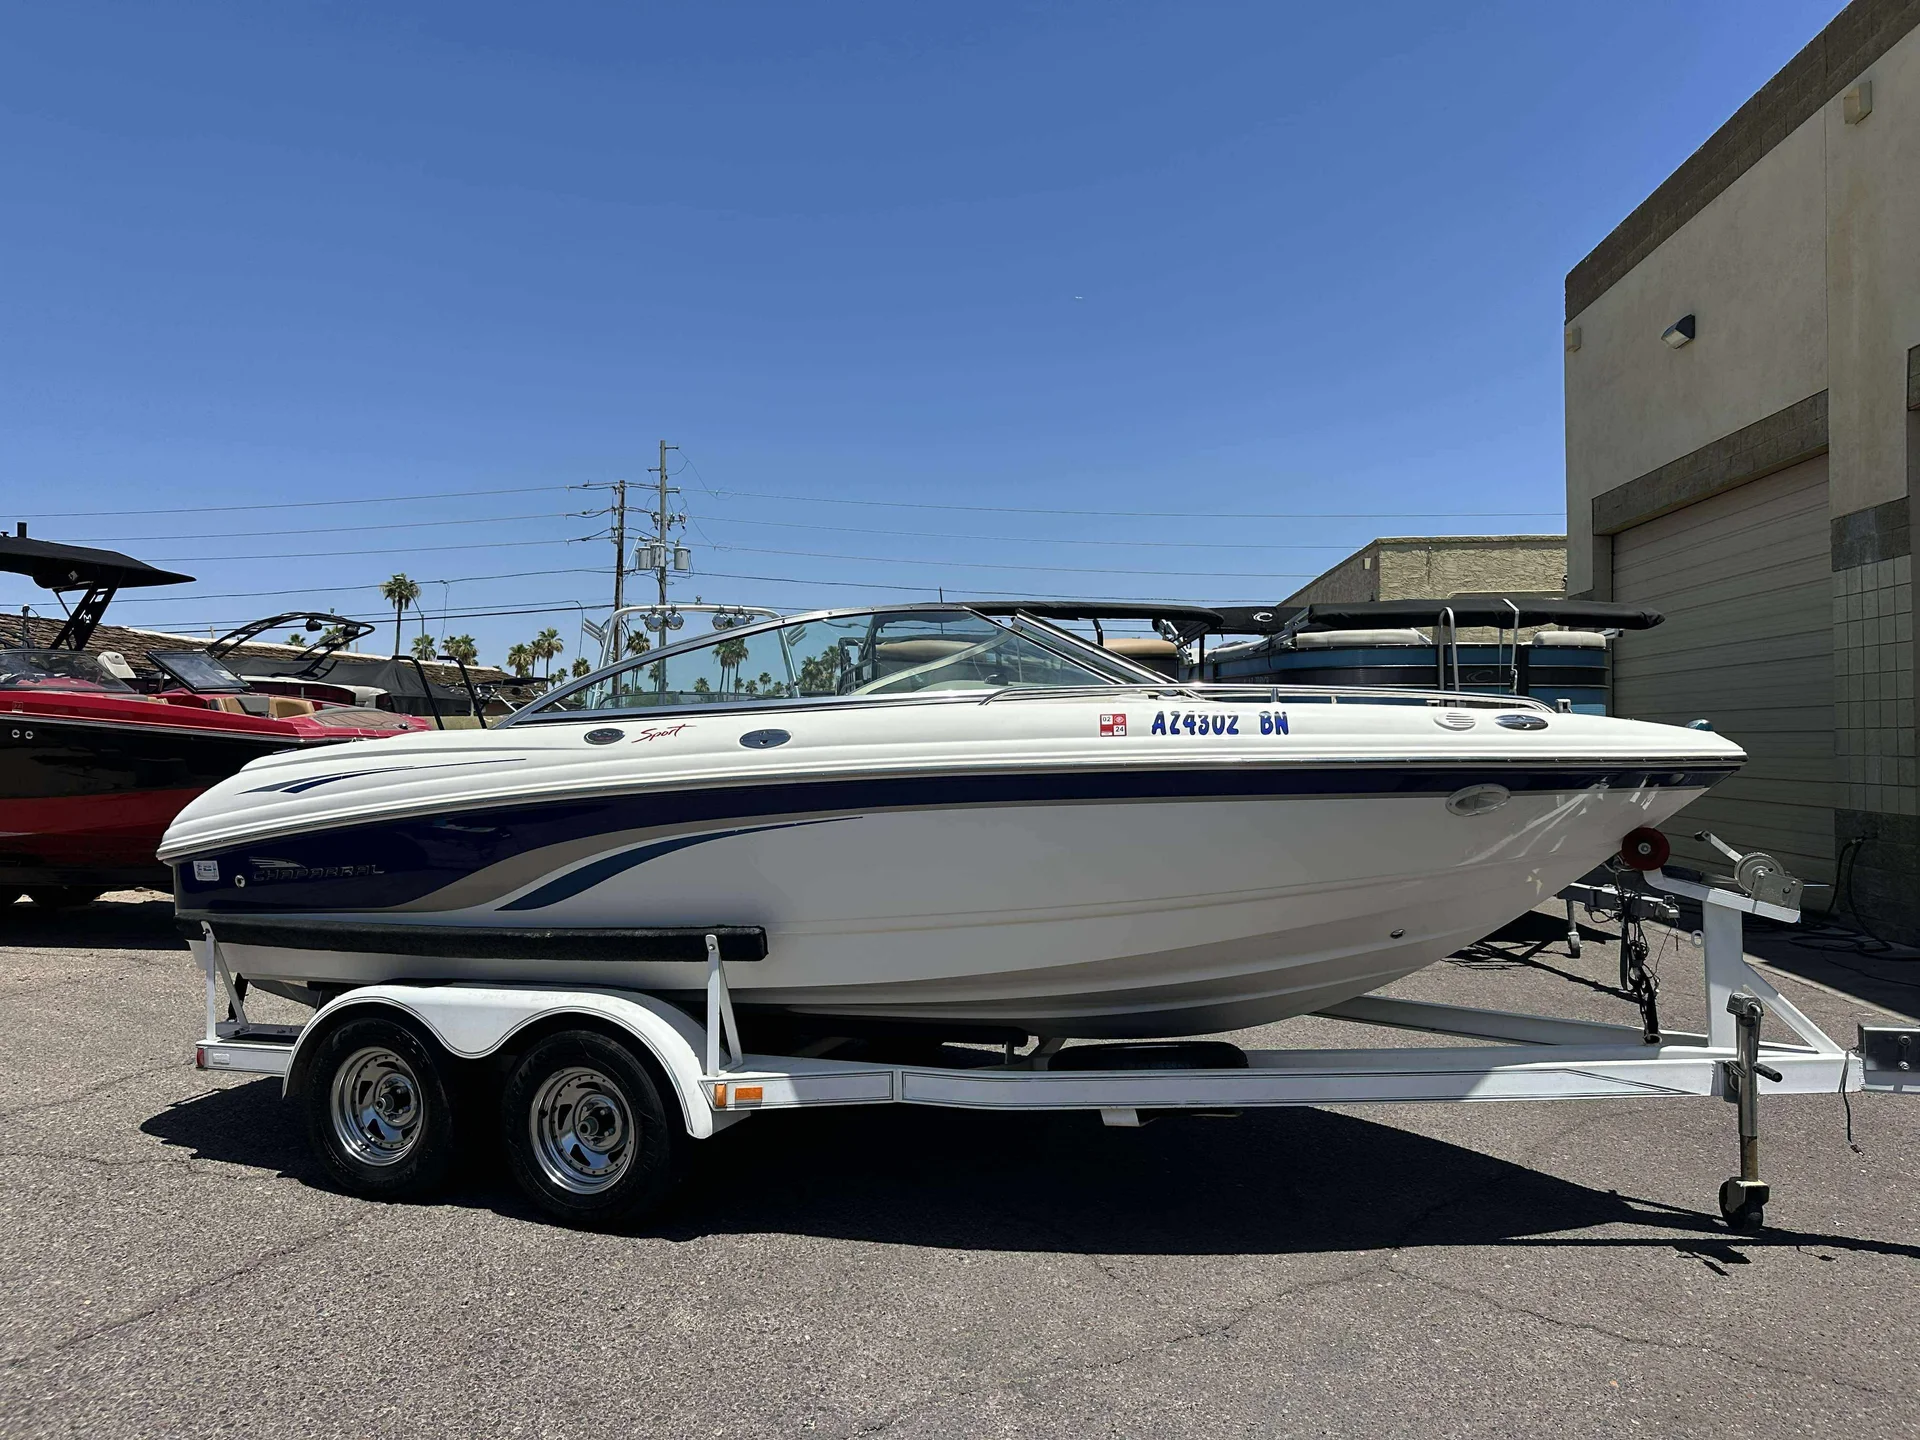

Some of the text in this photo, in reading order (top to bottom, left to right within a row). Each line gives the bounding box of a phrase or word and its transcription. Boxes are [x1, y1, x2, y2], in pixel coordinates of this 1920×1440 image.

[631, 723, 697, 743] Sport
[1258, 711, 1289, 735] BN
[252, 864, 385, 882] CHAPARRAL
